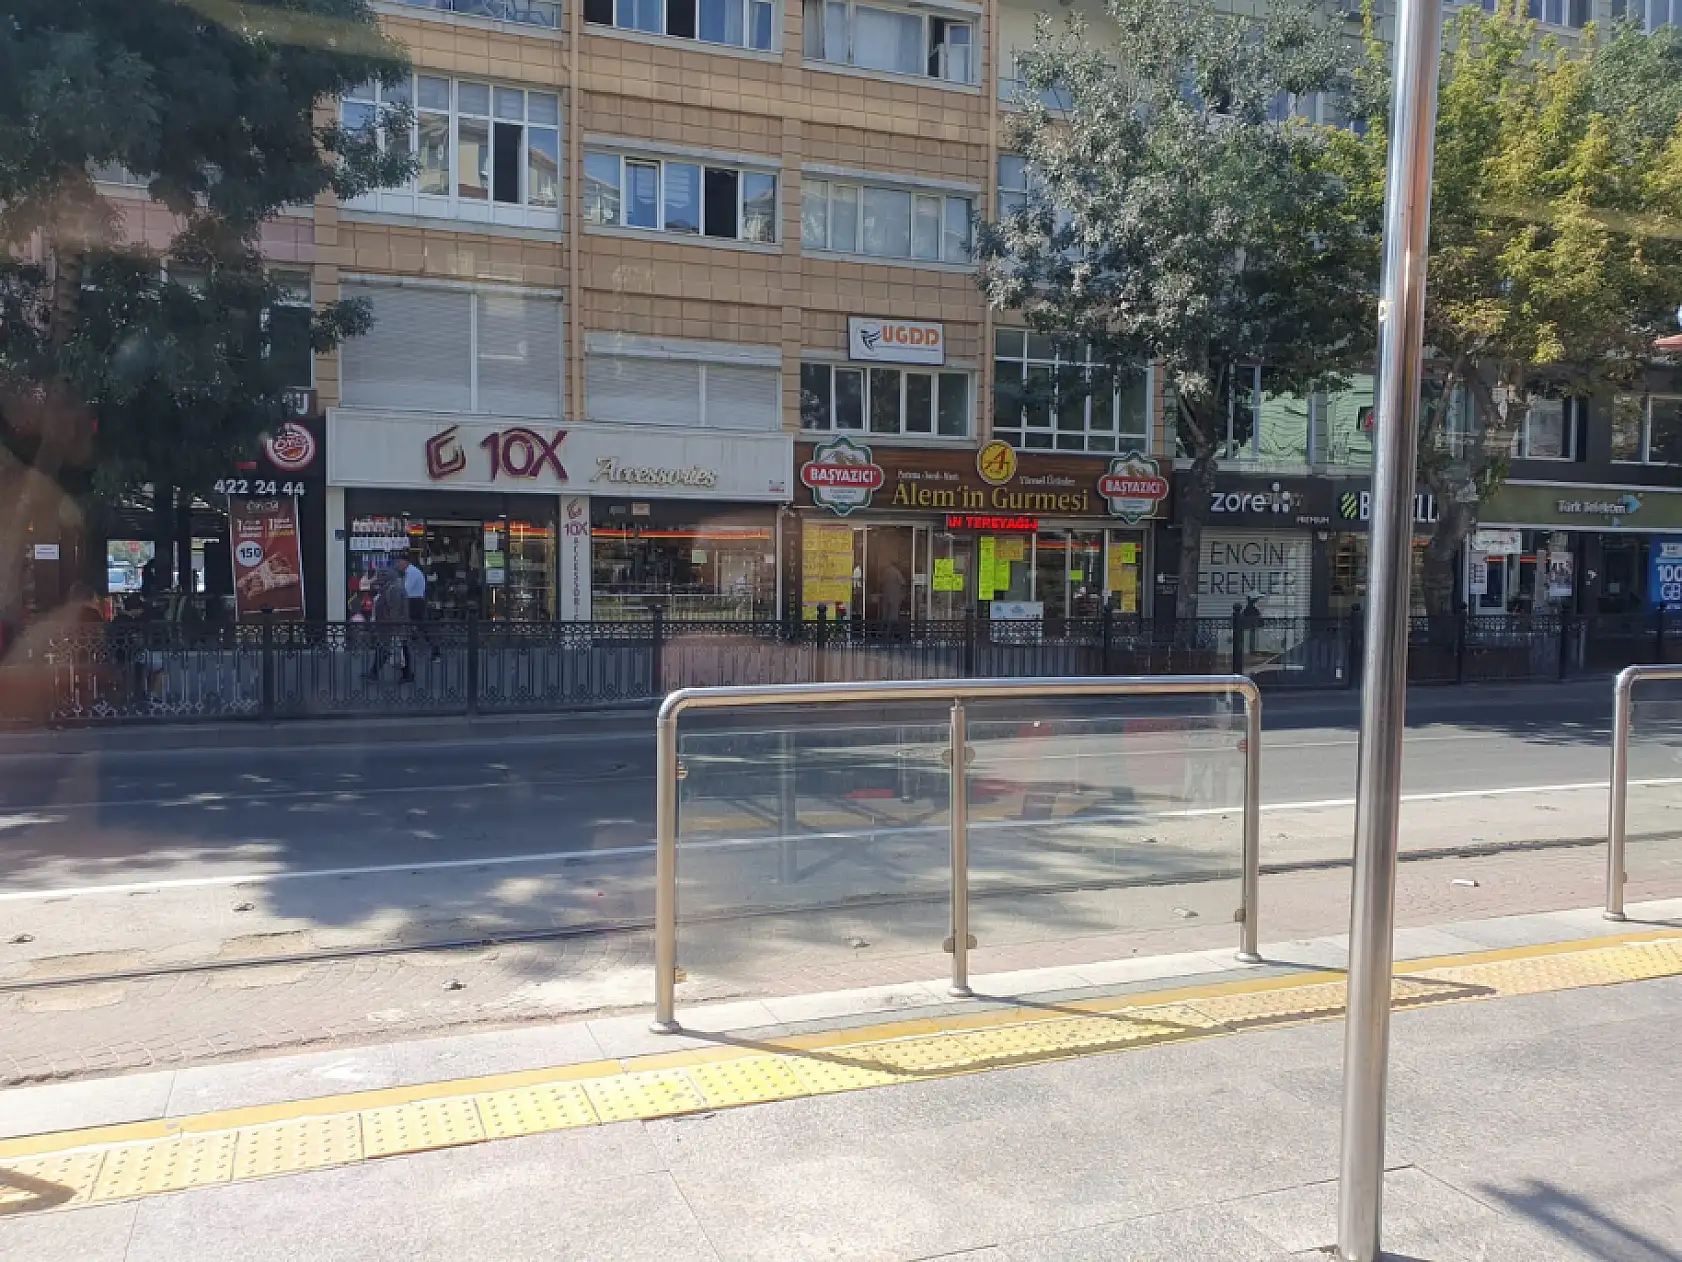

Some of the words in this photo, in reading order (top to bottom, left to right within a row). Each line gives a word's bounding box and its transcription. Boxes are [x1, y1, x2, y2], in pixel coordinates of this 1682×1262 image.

[882, 325, 940, 347] UGDD
[479, 426, 570, 482] 10X
[213, 479, 249, 494] 422
[255, 479, 277, 495] 24
[282, 481, 305, 496] 44
[810, 468, 873, 485] BAŞYAZICI
[992, 487, 1089, 511] Gurmesi
[1557, 500, 1582, 513] Türk
[1584, 500, 1626, 514] Telekom
[565, 521, 588, 537] 10X
[1210, 537, 1284, 565] ENGİN
[1198, 571, 1297, 595] ERENLER
